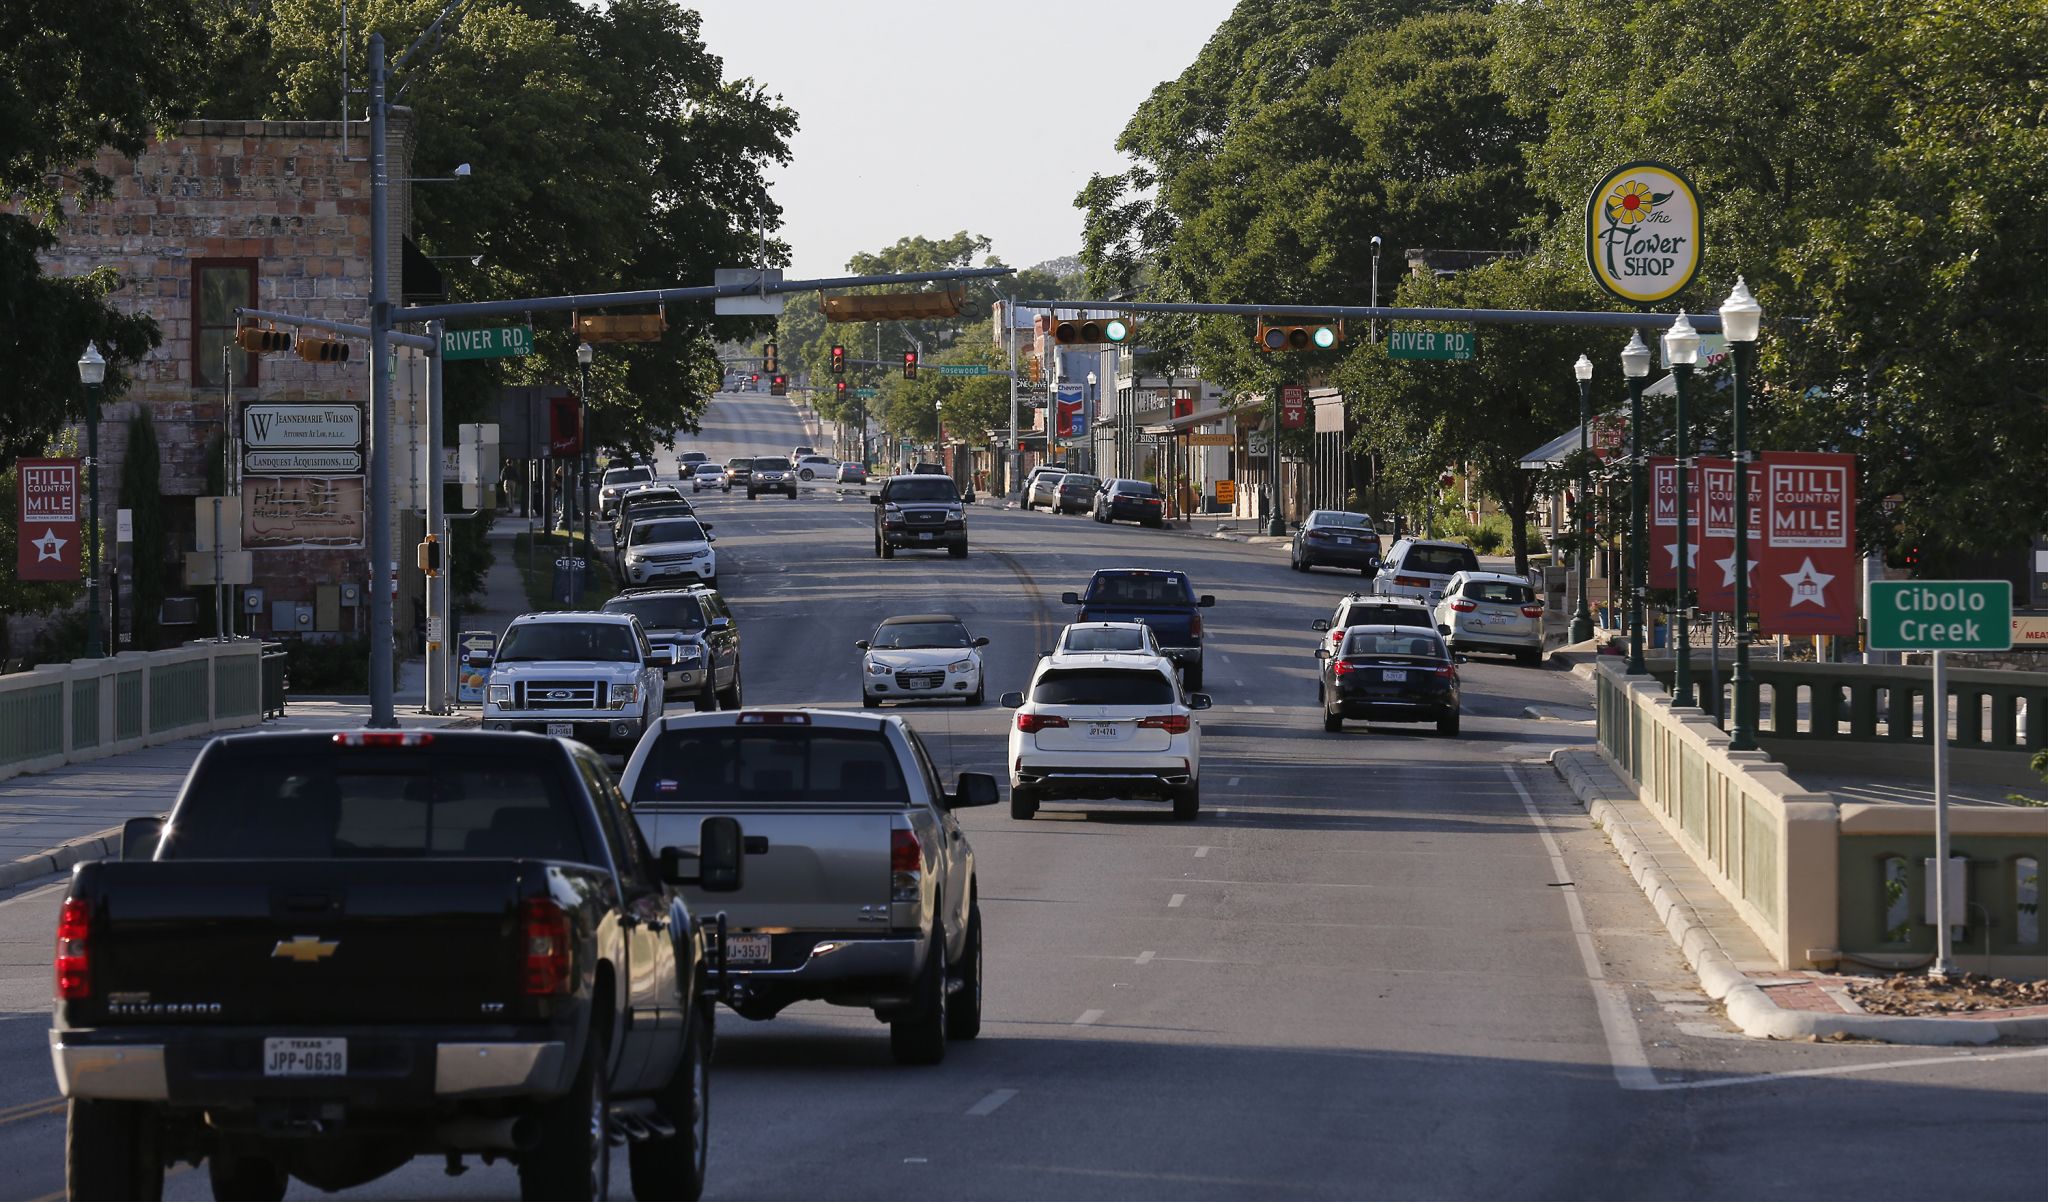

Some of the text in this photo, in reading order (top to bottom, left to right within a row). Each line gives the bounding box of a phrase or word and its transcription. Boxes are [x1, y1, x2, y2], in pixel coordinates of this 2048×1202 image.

[1647, 211, 1672, 223] The
[1598, 221, 1686, 280] Flower
[1624, 257, 1675, 276] SHOP
[445, 328, 529, 351] RIVER RD.
[1391, 332, 1470, 351] RIVER RD.
[940, 366, 979, 374] Rosewood
[249, 413, 273, 441] W
[1250, 444, 1267, 454] 30
[27, 471, 71, 485] HILL
[1776, 472, 1840, 492] HILL
[28, 496, 71, 510] MILE
[1776, 492, 1840, 503] COUNTRY
[1776, 510, 1840, 529] MILE
[1895, 588, 1985, 611] Cibolo
[1900, 618, 1981, 642] Creek
[109, 1003, 221, 1014] SILVERADO
[290, 1040, 322, 1049] TEXAS
